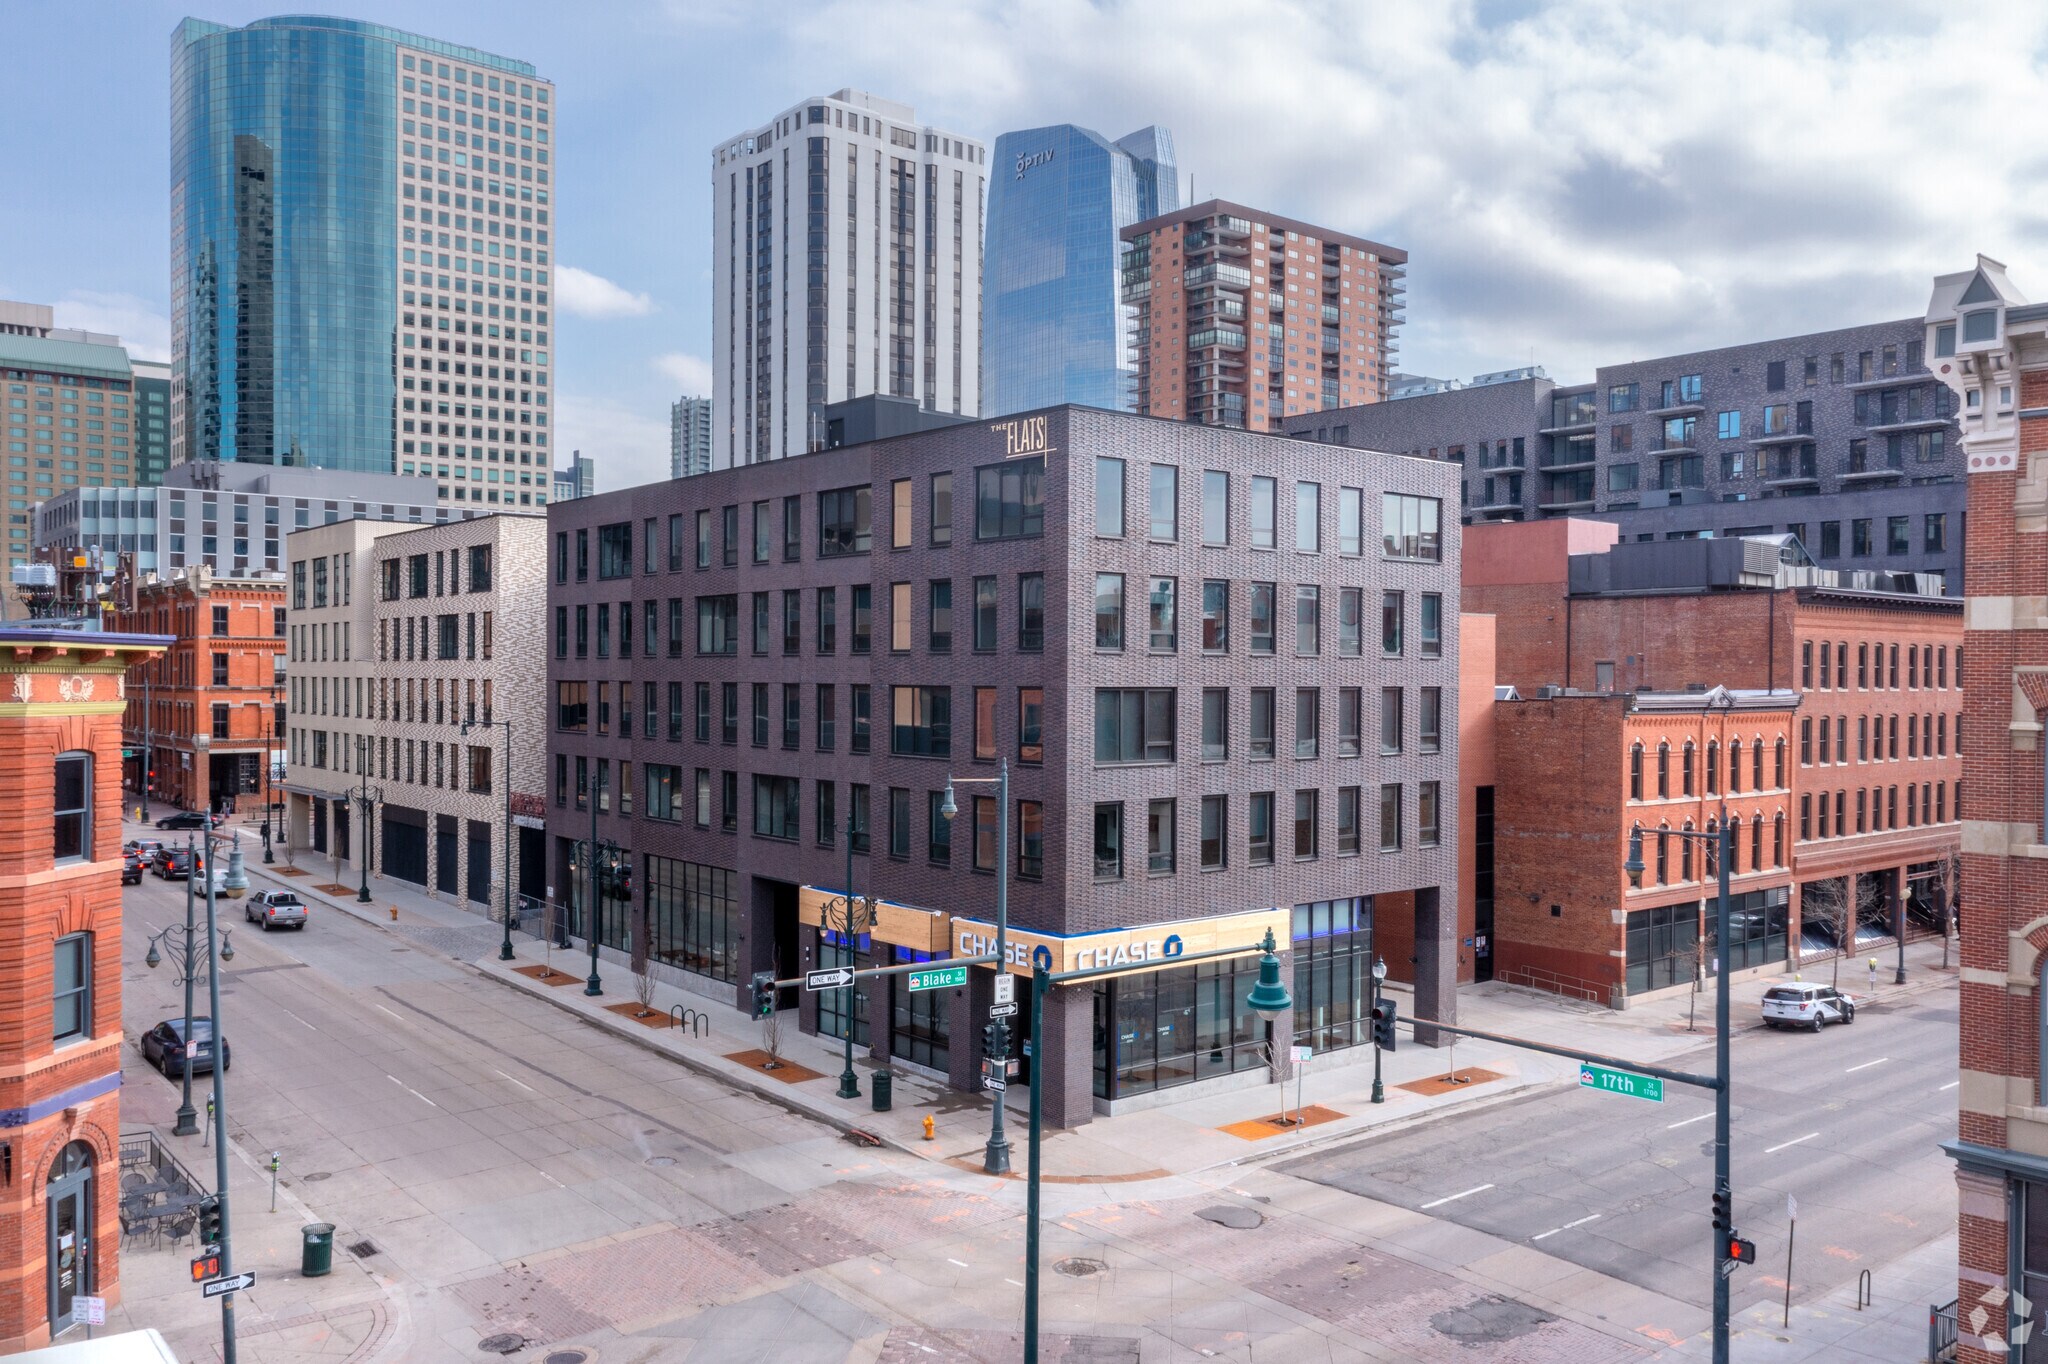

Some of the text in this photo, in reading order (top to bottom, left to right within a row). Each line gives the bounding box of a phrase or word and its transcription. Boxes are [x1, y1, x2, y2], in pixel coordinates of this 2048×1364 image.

[1016, 148, 1054, 175] OPTIV
[991, 416, 1044, 454] THE FLATS
[960, 932, 1028, 966] CHASE
[1077, 940, 1163, 971] CHASE
[812, 974, 840, 984] ONE WAY
[923, 973, 952, 987] Blake
[1601, 1073, 1634, 1093] 17th
[1643, 1089, 1658, 1097] 1700
[208, 1280, 239, 1292] ONE WAY
